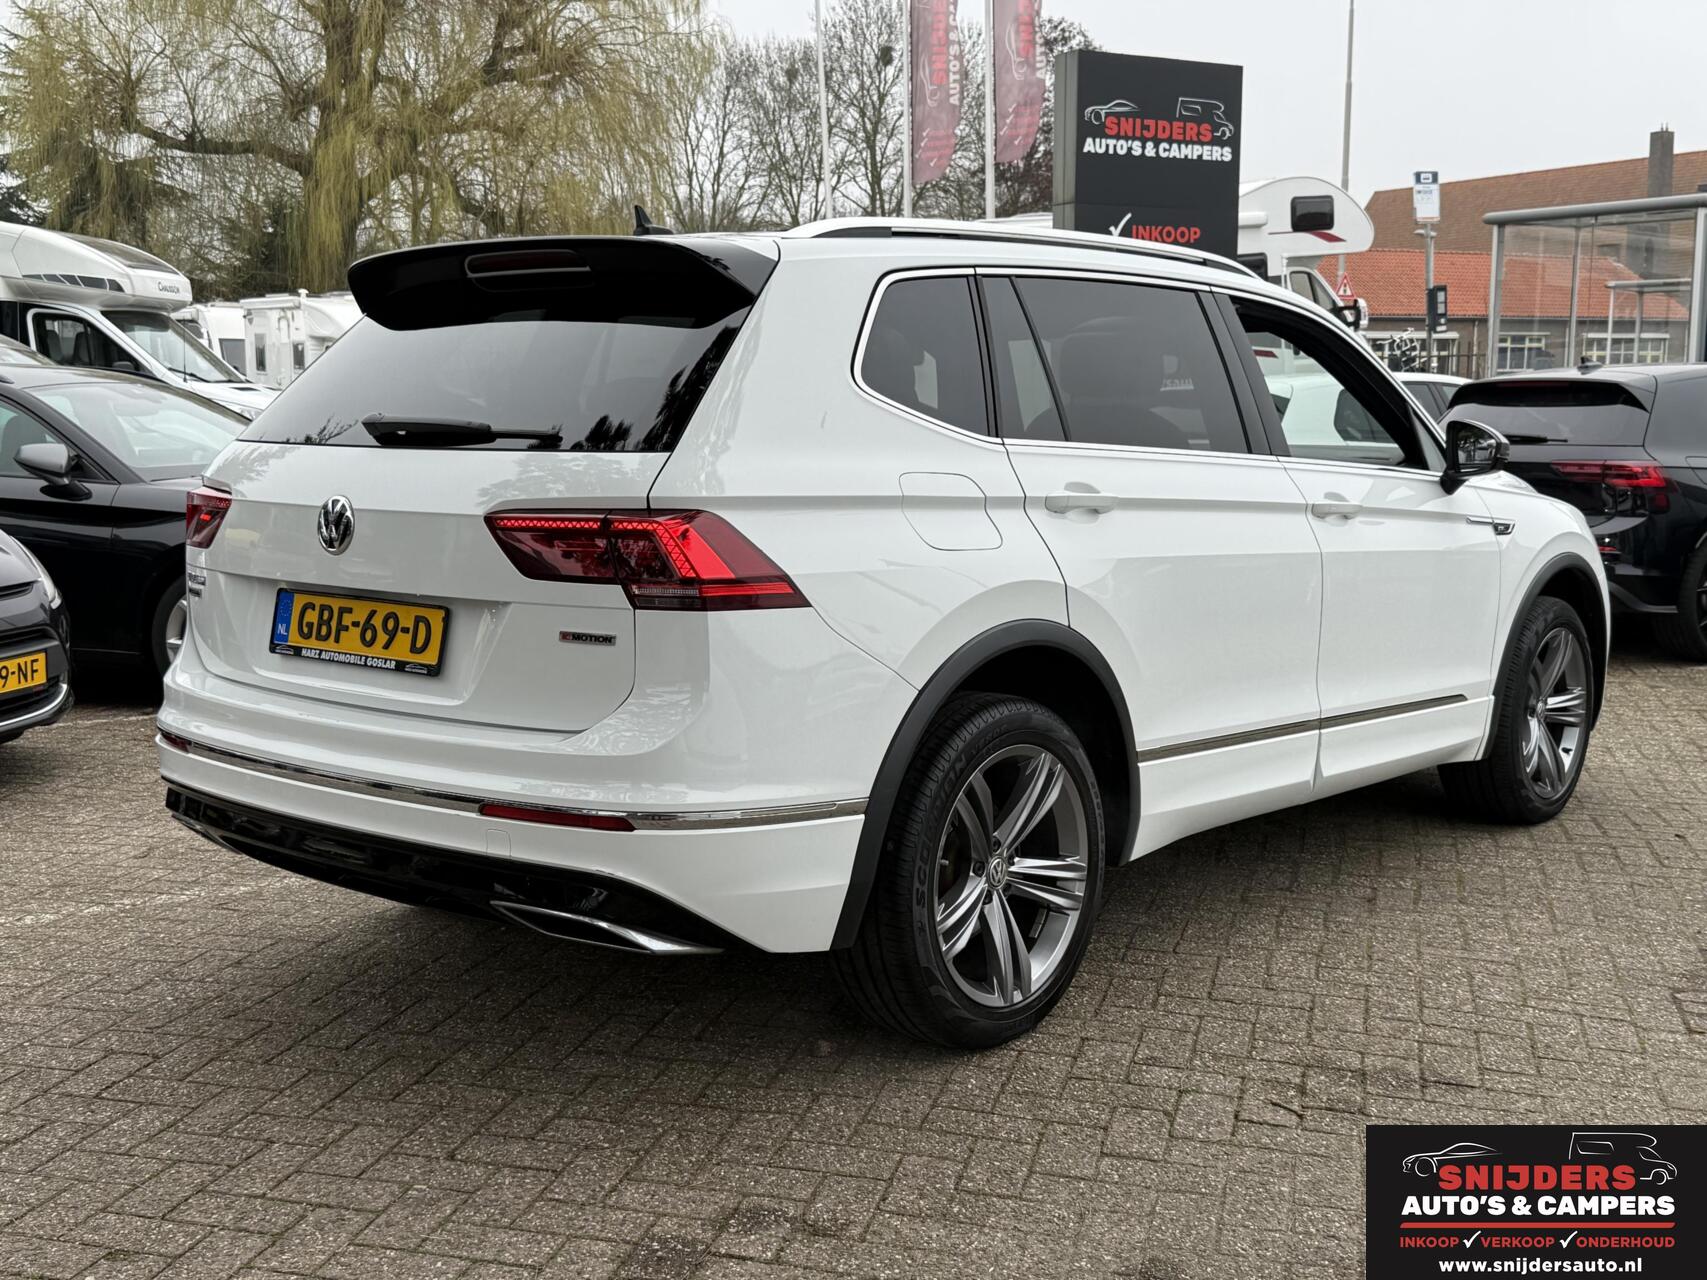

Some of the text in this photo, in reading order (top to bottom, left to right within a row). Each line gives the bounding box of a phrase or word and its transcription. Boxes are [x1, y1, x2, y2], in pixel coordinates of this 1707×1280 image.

[1104, 116, 1213, 142] SNIJDERS
[1083, 137, 1232, 162] AUTO'S & CAMPERS
[1131, 224, 1201, 244] INKOOP
[277, 623, 288, 635] NL
[297, 601, 432, 655] GBF-69-D
[301, 647, 396, 670] HARZ AUTOMOBILE GOSLAR
[0, 658, 40, 689] 9-NF
